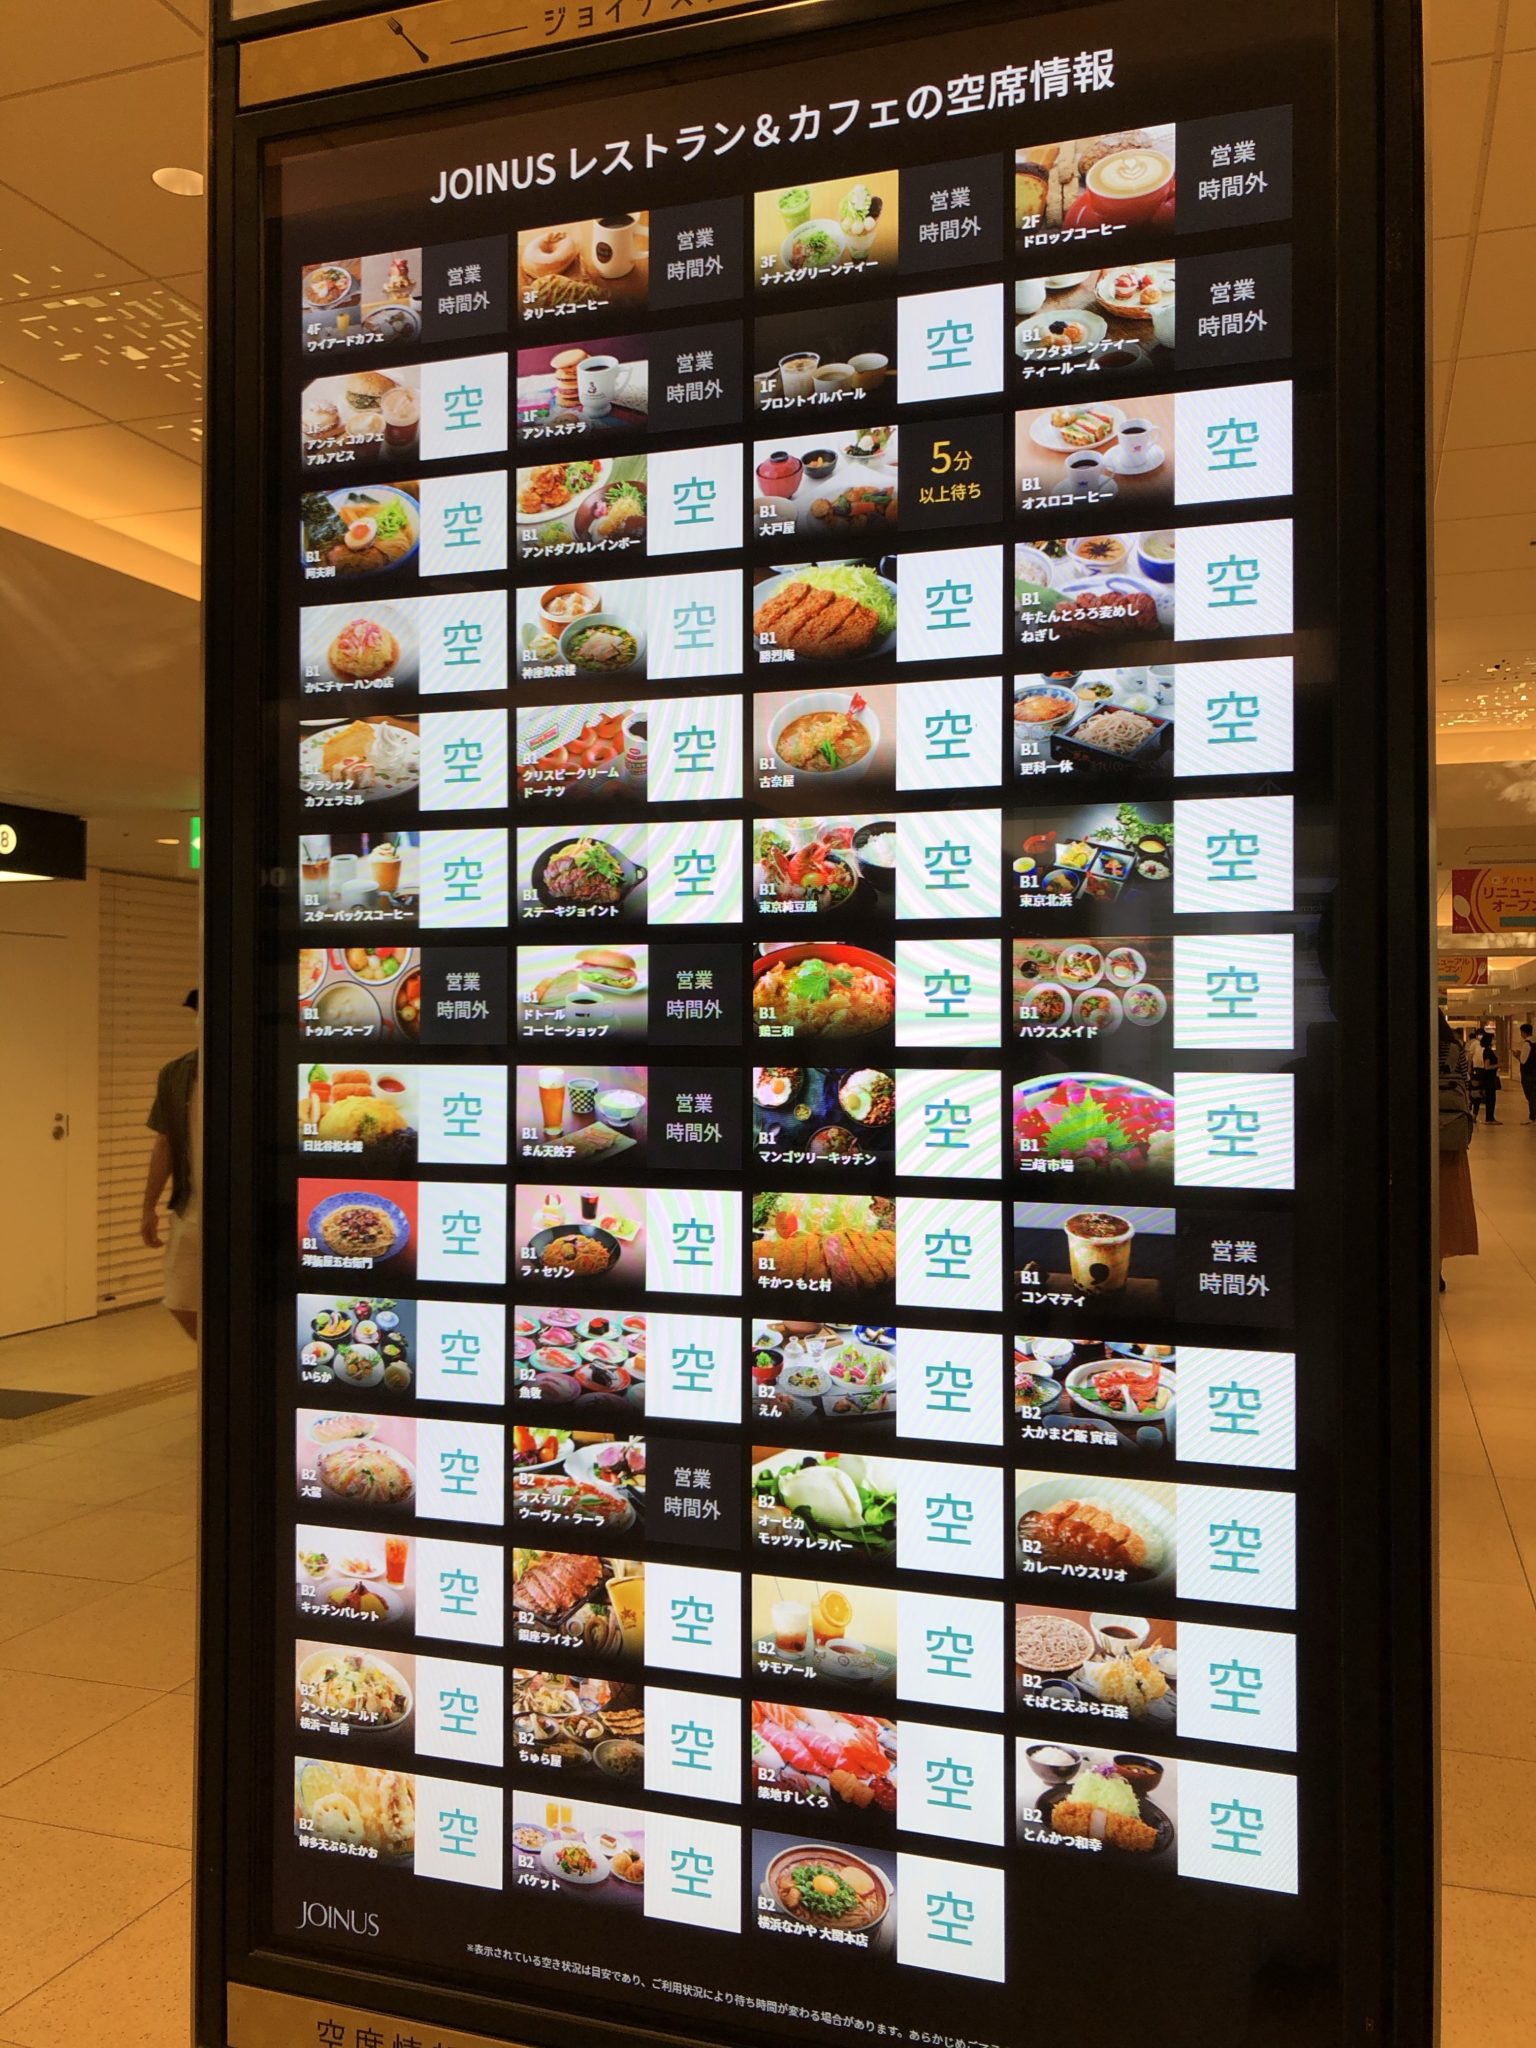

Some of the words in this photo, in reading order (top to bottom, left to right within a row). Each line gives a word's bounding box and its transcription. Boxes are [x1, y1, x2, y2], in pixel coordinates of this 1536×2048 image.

[1211, 140, 1256, 168] 営業
[430, 153, 557, 204] JOINUS
[1198, 171, 1268, 200] 時間外
[930, 187, 971, 212] 営業
[919, 216, 981, 244] 時間外
[1022, 214, 1040, 230] 2F
[678, 228, 714, 252] 営業
[1024, 223, 1126, 248] ドロップコーヒー
[667, 256, 724, 281] 時間外
[760, 255, 777, 268] 3F
[448, 265, 481, 286] 営業
[760, 260, 878, 286] ナナズグリーンティー
[524, 290, 538, 303] 3F
[1210, 278, 1256, 305] 営業
[438, 292, 490, 315] 時間外
[524, 300, 608, 320] タリーズコーヒー
[307, 324, 321, 335] 4F
[1198, 310, 1268, 337] 時間外
[307, 333, 384, 352] ワイアードカフェ
[927, 320, 974, 370] 空
[1022, 329, 1040, 342] B1
[1022, 338, 1140, 360] アフタヌーンティー
[677, 350, 714, 374] 営業
[1022, 359, 1100, 379] ティールーム
[666, 380, 723, 404] 時間外
[445, 385, 483, 430] 空
[523, 422, 586, 440] アントステラ
[1207, 417, 1259, 470] 空
[931, 440, 972, 474] 5分
[674, 477, 716, 525] 空
[920, 482, 981, 504] 以上待ち
[1022, 491, 1114, 510] オスロコーヒー
[760, 506, 776, 518] B1
[760, 522, 795, 536] 大戸屋
[305, 551, 321, 562] B1
[522, 538, 640, 558] アンドダブルレインボー
[927, 579, 973, 630] 空
[1022, 592, 1040, 605] B1
[1022, 604, 1140, 625] 牛たんとろろ麦めし
[444, 620, 483, 665] 空
[1022, 628, 1060, 643] ねぎし
[522, 650, 538, 662] B1
[305, 677, 394, 694] かにチャーハンの店
[1207, 691, 1260, 744] 空
[674, 725, 716, 773] 空
[444, 738, 483, 783] 空
[760, 758, 776, 770] B1
[1020, 760, 1074, 775] 更科一休
[523, 767, 619, 782] クリスピークリーム
[760, 776, 794, 788] 古奈屋
[305, 796, 364, 807] カフェラミル
[524, 786, 565, 798] ドーナツ
[925, 840, 972, 889] 空
[444, 856, 483, 901] 空
[1020, 876, 1038, 888] B1
[523, 890, 538, 901] B1
[1020, 894, 1072, 907] 東京北浜
[304, 910, 414, 922] スターバックスコーヒー
[523, 906, 619, 918] ステーキジョイント
[446, 972, 480, 992] 営業
[676, 970, 713, 990] 営業
[1206, 966, 1259, 1018] 空
[437, 1001, 490, 1020] 時間外
[524, 1010, 566, 1020] ドトール
[666, 1000, 722, 1019] 時間外
[760, 1007, 776, 1019] B1
[523, 1026, 608, 1036] コーヒーショップ
[1020, 1026, 1098, 1038] ハウスメイド
[443, 1092, 482, 1136] 空
[676, 1094, 712, 1114] 営業
[666, 1123, 722, 1142] 時間外
[925, 1099, 972, 1148] 空
[522, 1145, 576, 1158] まん天餃子
[1020, 1140, 1039, 1152] B1
[759, 1151, 876, 1166] マンゴツリーキッチン
[303, 1238, 318, 1250] B1
[673, 1218, 715, 1266] 空
[1211, 1240, 1258, 1263] 営業
[758, 1258, 776, 1270] B1
[1021, 1272, 1040, 1284] B1
[1200, 1272, 1270, 1297] 時間外
[1022, 1292, 1086, 1307] コンマティ
[441, 1329, 480, 1375] 空
[302, 1371, 332, 1383] いらか
[520, 1369, 536, 1381] B2
[926, 1361, 973, 1412] 空
[759, 1405, 782, 1418] えん
[1022, 1406, 1042, 1420] B2
[302, 1469, 316, 1480] B2
[674, 1468, 711, 1490] 営業
[519, 1492, 572, 1504] オステリア
[664, 1496, 720, 1520] 時間外
[758, 1495, 776, 1508] B2
[758, 1533, 852, 1552] モッツァレラバー
[1210, 1520, 1262, 1574] 空
[1023, 1560, 1128, 1582] カレーハウスリオ
[440, 1569, 478, 1615] 空
[519, 1612, 534, 1624] B2
[518, 1629, 583, 1648] 銀座ライオン
[927, 1626, 974, 1678] 空
[758, 1660, 816, 1678] サモアール
[1023, 1674, 1042, 1688] B2
[440, 1687, 479, 1735] 空
[672, 1721, 714, 1770] 空
[519, 1749, 562, 1768] ちゅら屋
[758, 1768, 776, 1782] B2
[439, 1809, 478, 1856] 空
[1211, 1799, 1264, 1857] 空
[1024, 1828, 1102, 1852] とんかつ和幸
[518, 1856, 534, 1868] B2
[296, 1901, 380, 1936] JOINUS
[927, 1891, 974, 1946] 空
